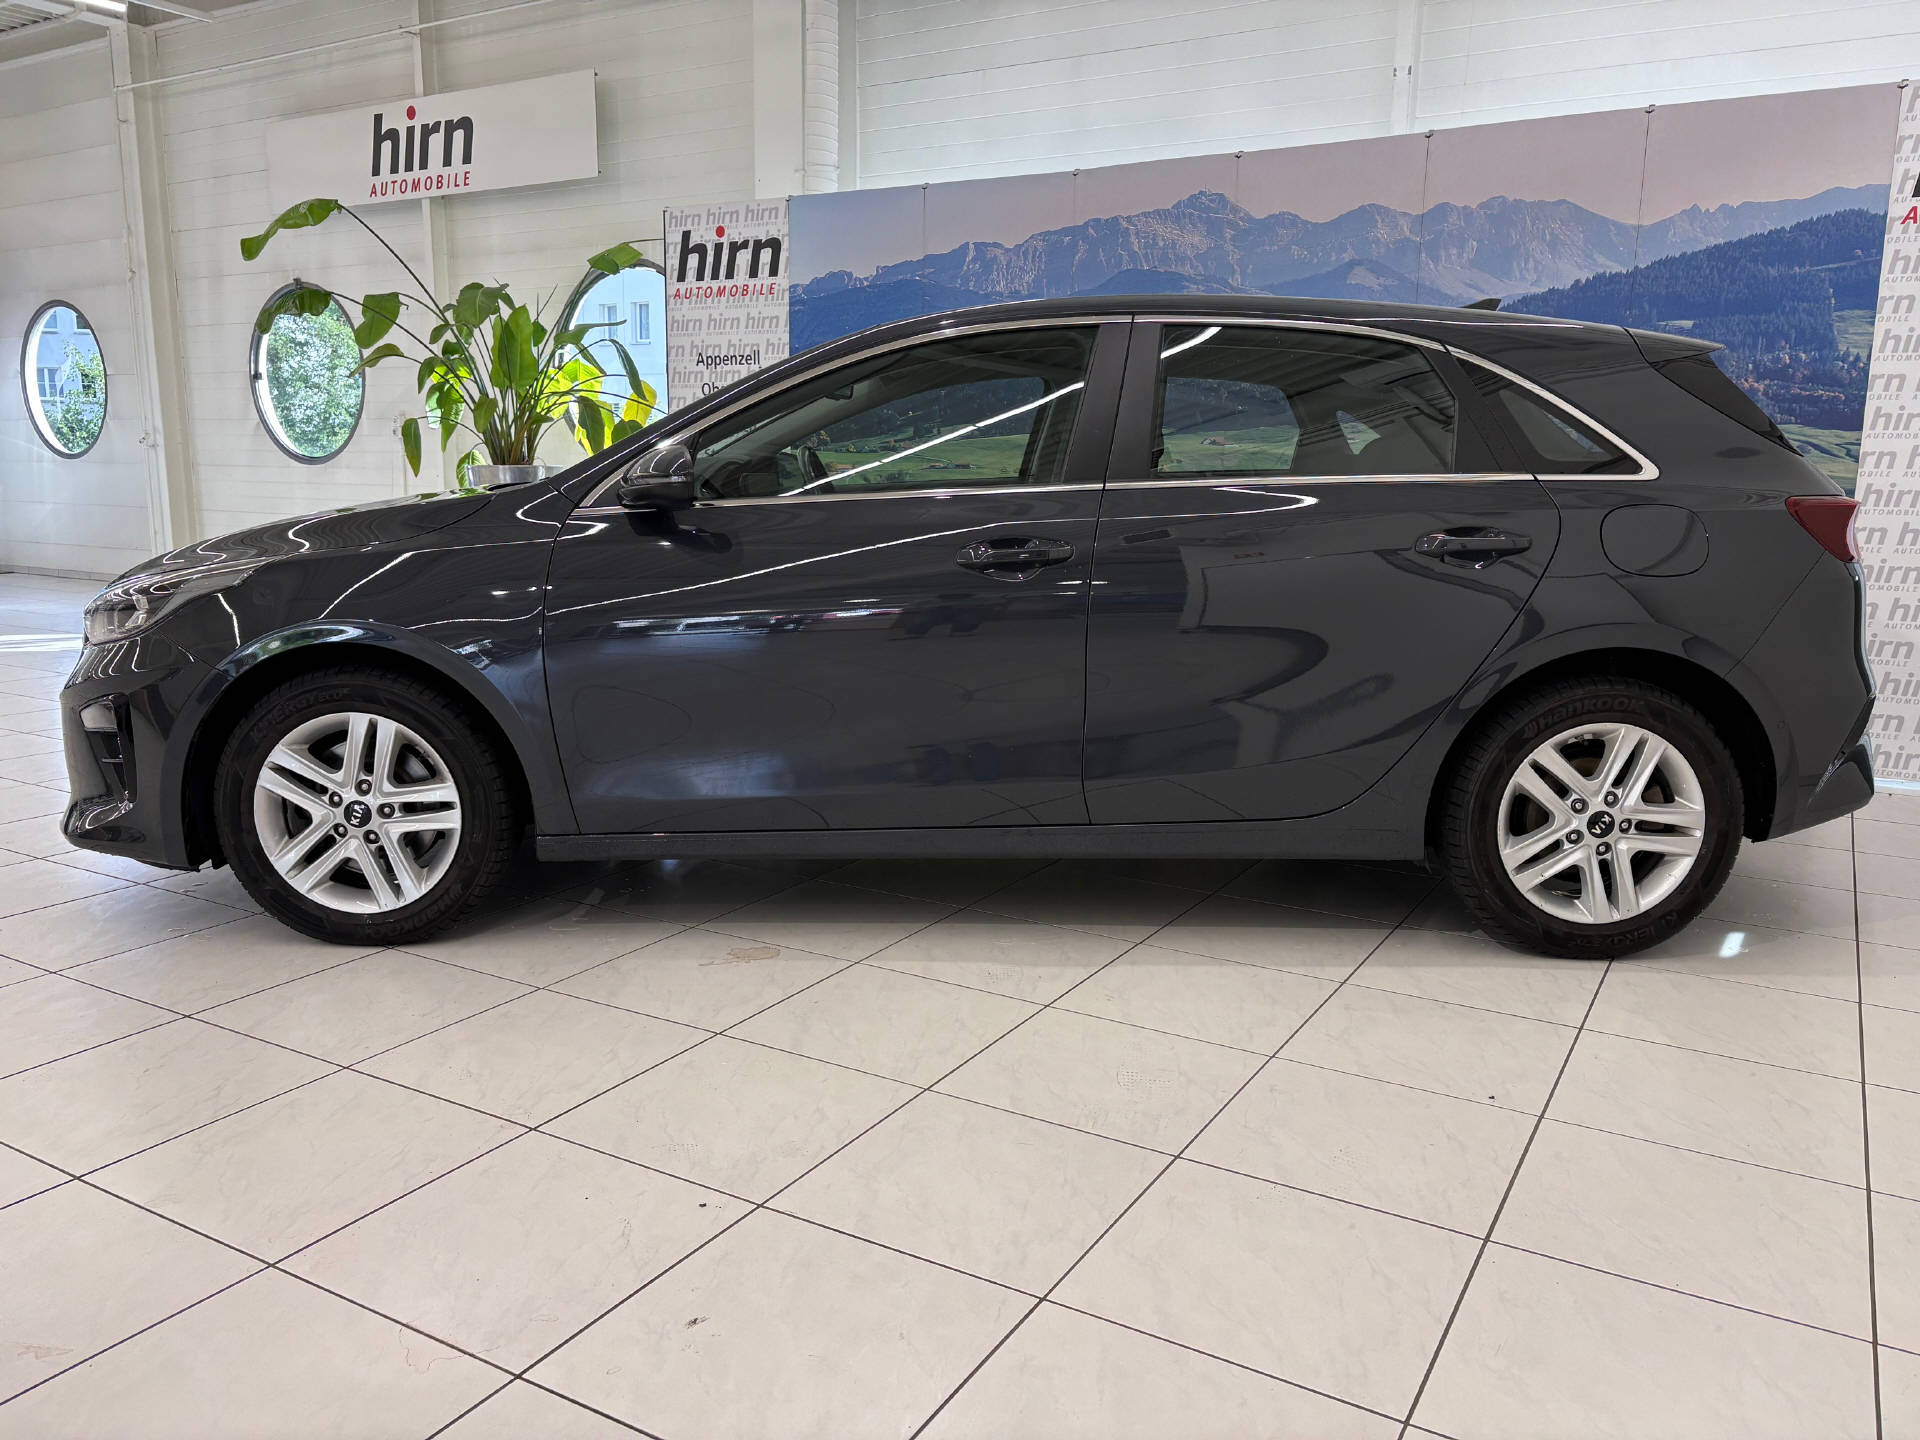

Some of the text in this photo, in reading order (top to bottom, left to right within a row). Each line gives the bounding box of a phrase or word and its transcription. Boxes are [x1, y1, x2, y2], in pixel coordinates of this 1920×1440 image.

[371, 105, 474, 177] hirn
[369, 170, 471, 198] AUTOMOBILE
[706, 206, 739, 225] hirn
[744, 203, 779, 222] hirn
[676, 225, 782, 282] hirn
[673, 282, 776, 300] AUTOMOBILE
[1877, 294, 1916, 314] rn
[670, 311, 779, 332] hirn hirn hirn
[765, 337, 788, 355] hir
[696, 349, 760, 370] Appenzell
[671, 366, 704, 383] hirn
[1868, 373, 1907, 393] rn
[1869, 405, 1920, 431] hir
[1860, 450, 1897, 469] rn
[1867, 632, 1915, 660] irn
[1871, 713, 1904, 732] rn
[1873, 743, 1920, 772] hir
[350, 803, 368, 826] KIA
[1591, 814, 1612, 835] KIA
